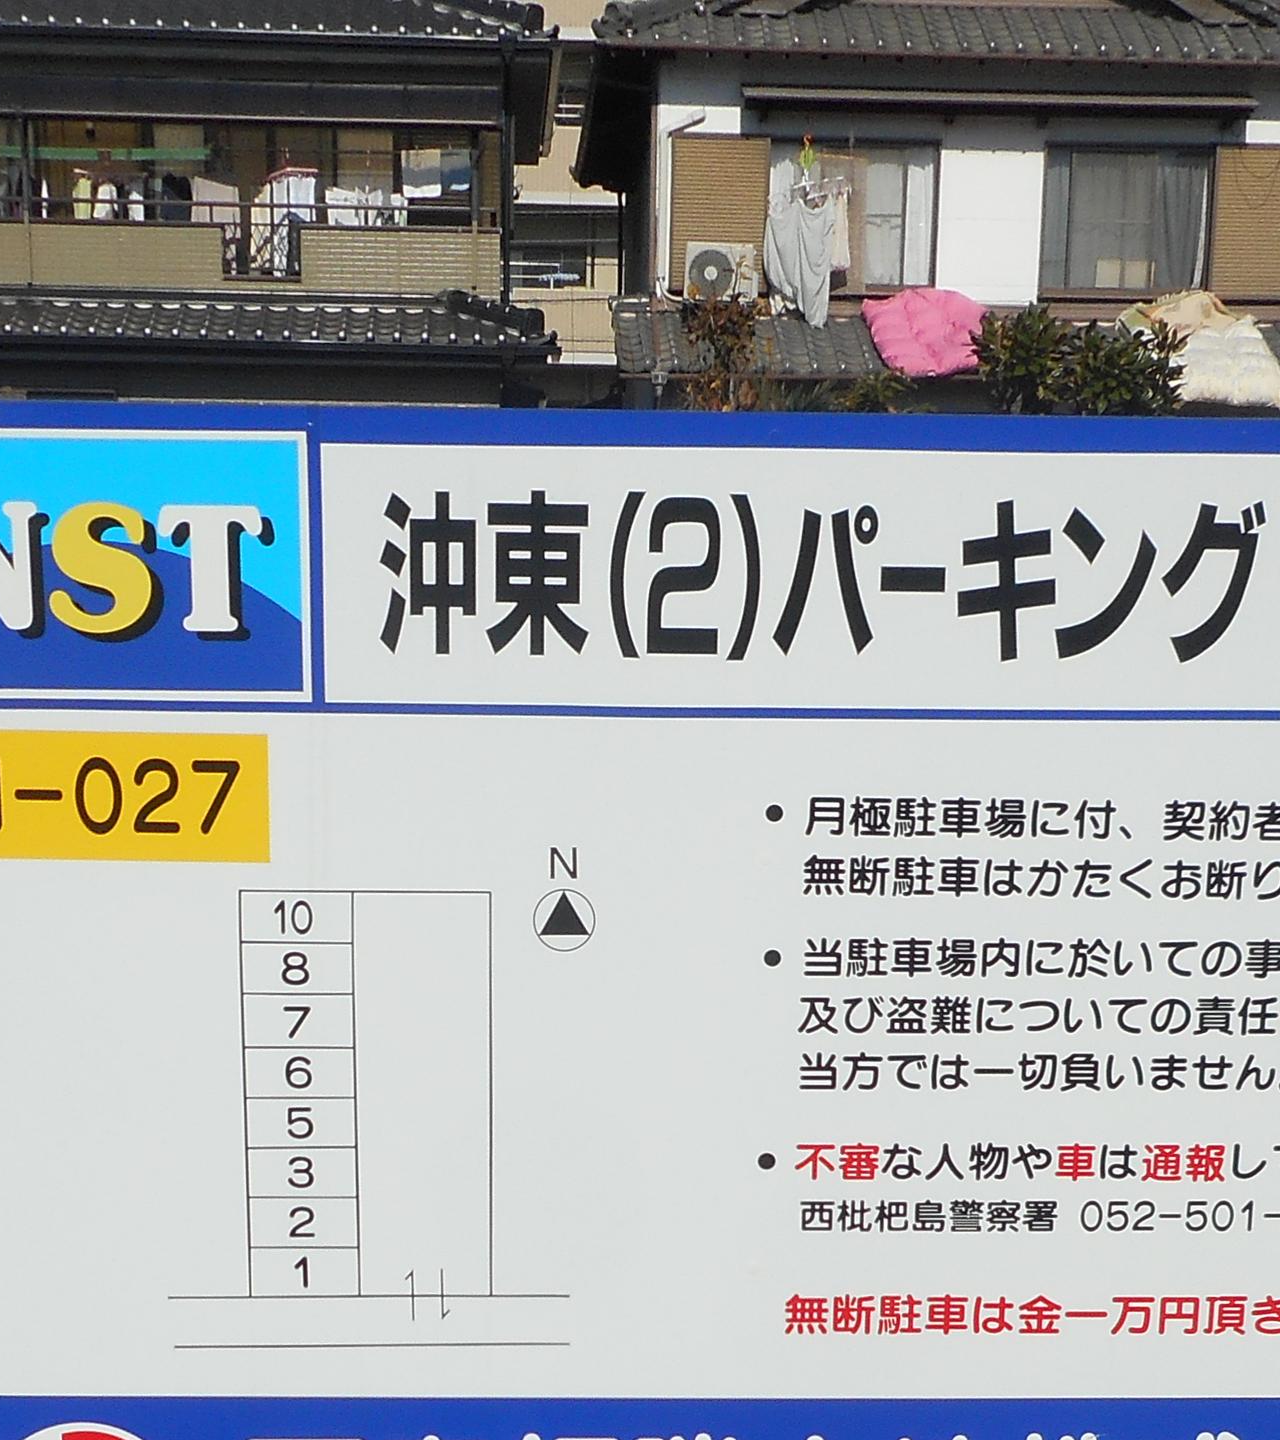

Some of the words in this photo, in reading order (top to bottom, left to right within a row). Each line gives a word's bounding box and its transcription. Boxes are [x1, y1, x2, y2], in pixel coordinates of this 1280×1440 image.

[380, 491, 1265, 662] 沖東(2)パーキング
[551, 847, 578, 879] N
[274, 900, 313, 935] 10
[281, 952, 310, 985] 8
[283, 1006, 311, 1038] 7
[285, 1056, 312, 1089] 6
[287, 1107, 314, 1139] 5
[287, 1157, 314, 1188] 3
[289, 1206, 315, 1237] 2
[801, 1200, 1058, 1232] 西枇杷島警察署
[294, 1257, 309, 1288] 1
